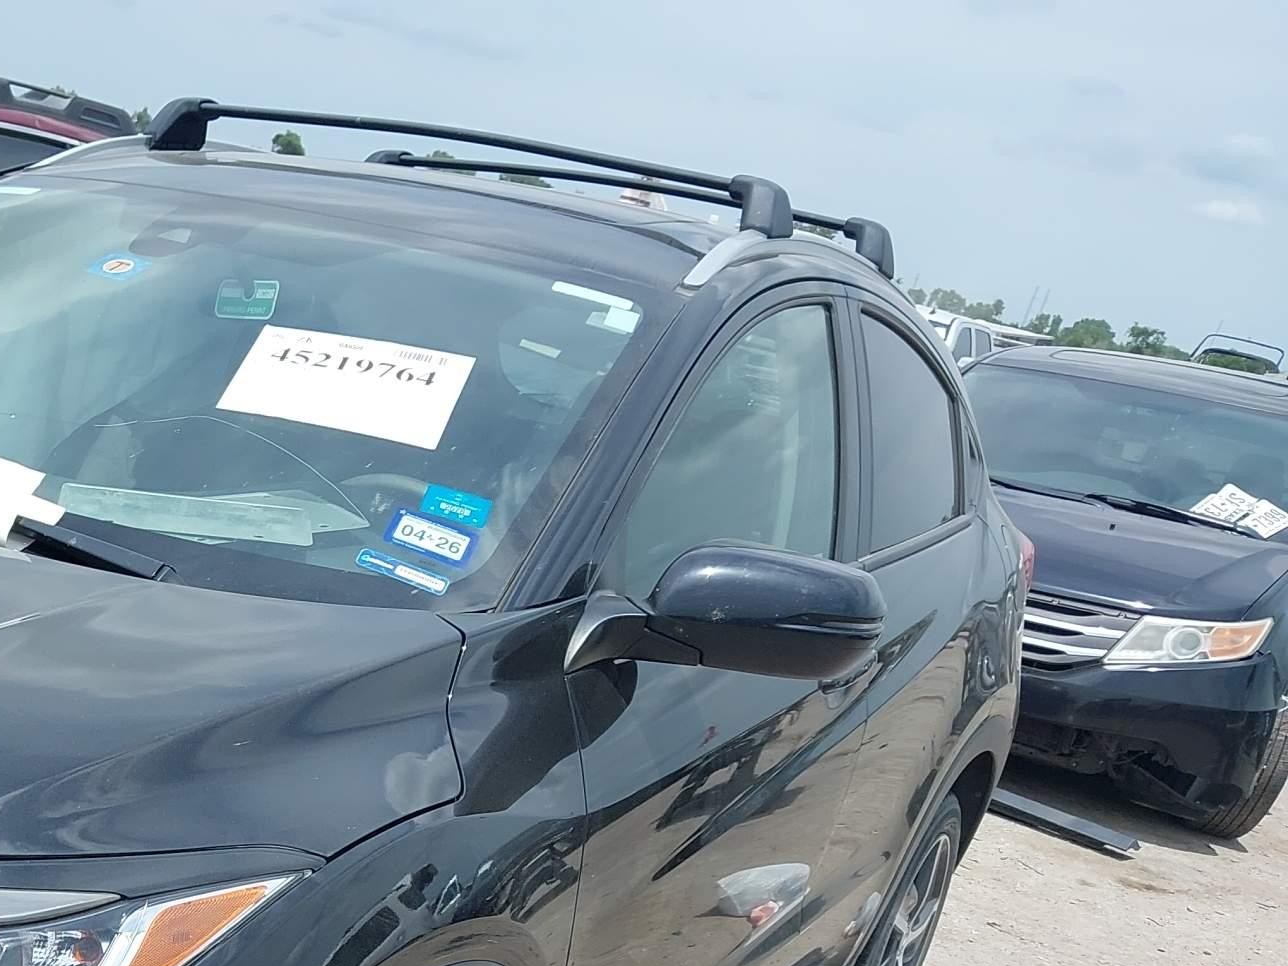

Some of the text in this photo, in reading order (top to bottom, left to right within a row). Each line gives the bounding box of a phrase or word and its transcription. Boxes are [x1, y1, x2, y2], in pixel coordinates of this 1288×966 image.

[271, 347, 437, 387] 45219764
[401, 524, 427, 542] 04
[435, 536, 462, 555] 26
